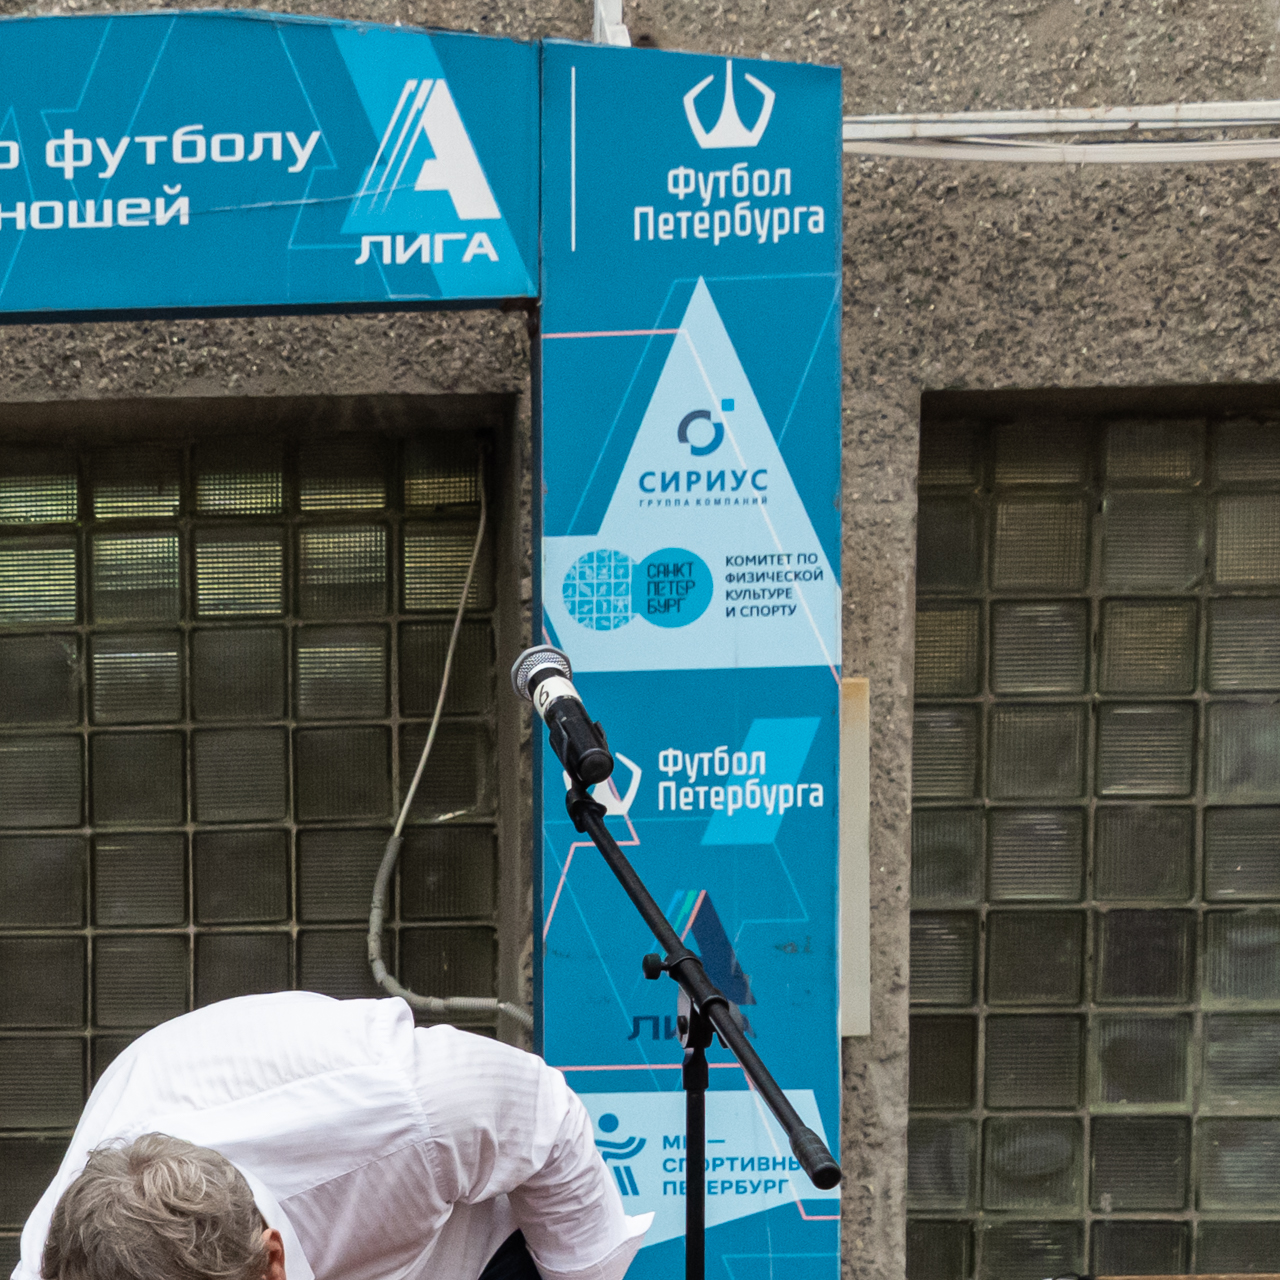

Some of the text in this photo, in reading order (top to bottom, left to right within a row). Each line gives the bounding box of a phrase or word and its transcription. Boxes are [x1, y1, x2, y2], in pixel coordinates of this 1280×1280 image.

[45, 124, 322, 180] футболу
[667, 161, 792, 208] Футбол
[633, 200, 825, 247] Петербурга
[354, 231, 500, 265] ЛИГА
[638, 468, 769, 494] СИРИУС
[639, 495, 769, 508] ГРУППА КОМПАНИЙ
[725, 552, 819, 567] КОМИТЕТ ПО
[725, 567, 824, 584] ФИЗИЧЕСКОЙ
[725, 587, 794, 601] КУЛЬТУРЕ
[646, 597, 688, 615] БУРГ
[725, 604, 798, 618] И СПОРТУ
[658, 746, 766, 783] Футбол
[658, 779, 824, 816] Петербурга
[662, 1179, 790, 1196] ПЕЕРБУРГ
